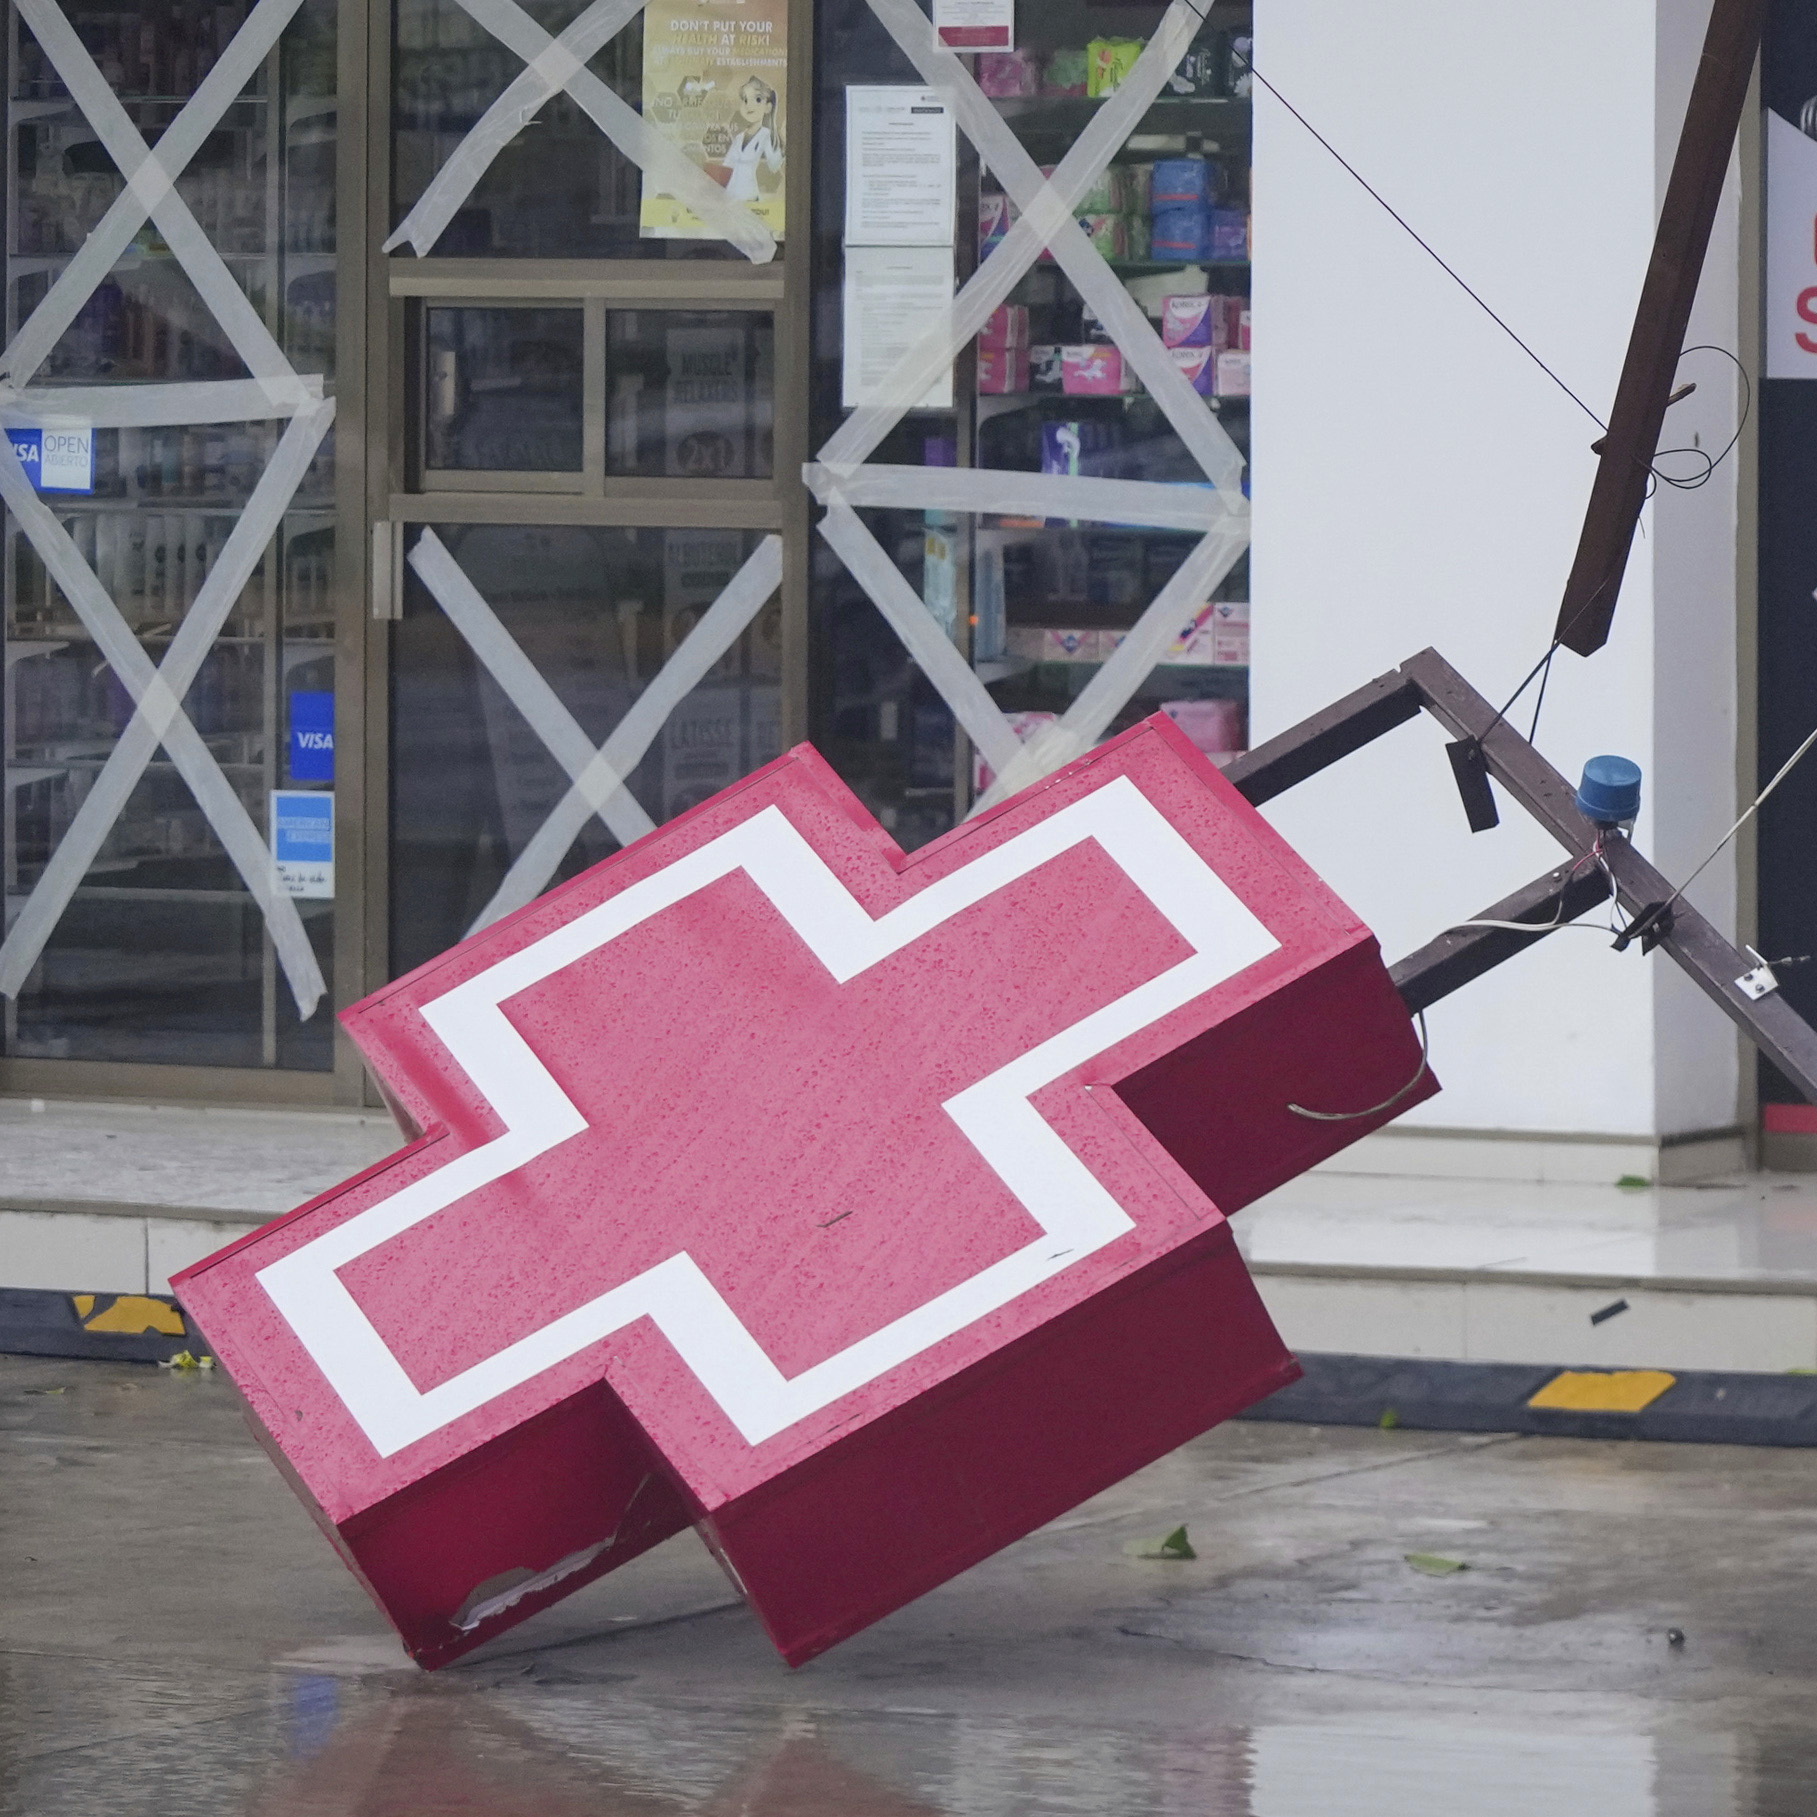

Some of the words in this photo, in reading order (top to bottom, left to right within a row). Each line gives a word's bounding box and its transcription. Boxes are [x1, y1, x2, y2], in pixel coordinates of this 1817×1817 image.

[671, 20, 708, 32] DON'T
[713, 20, 736, 32] PUT
[740, 20, 773, 33] YOUR
[720, 34, 737, 45] AT
[44, 435, 89, 453] OPEN
[298, 733, 333, 749] VISA
